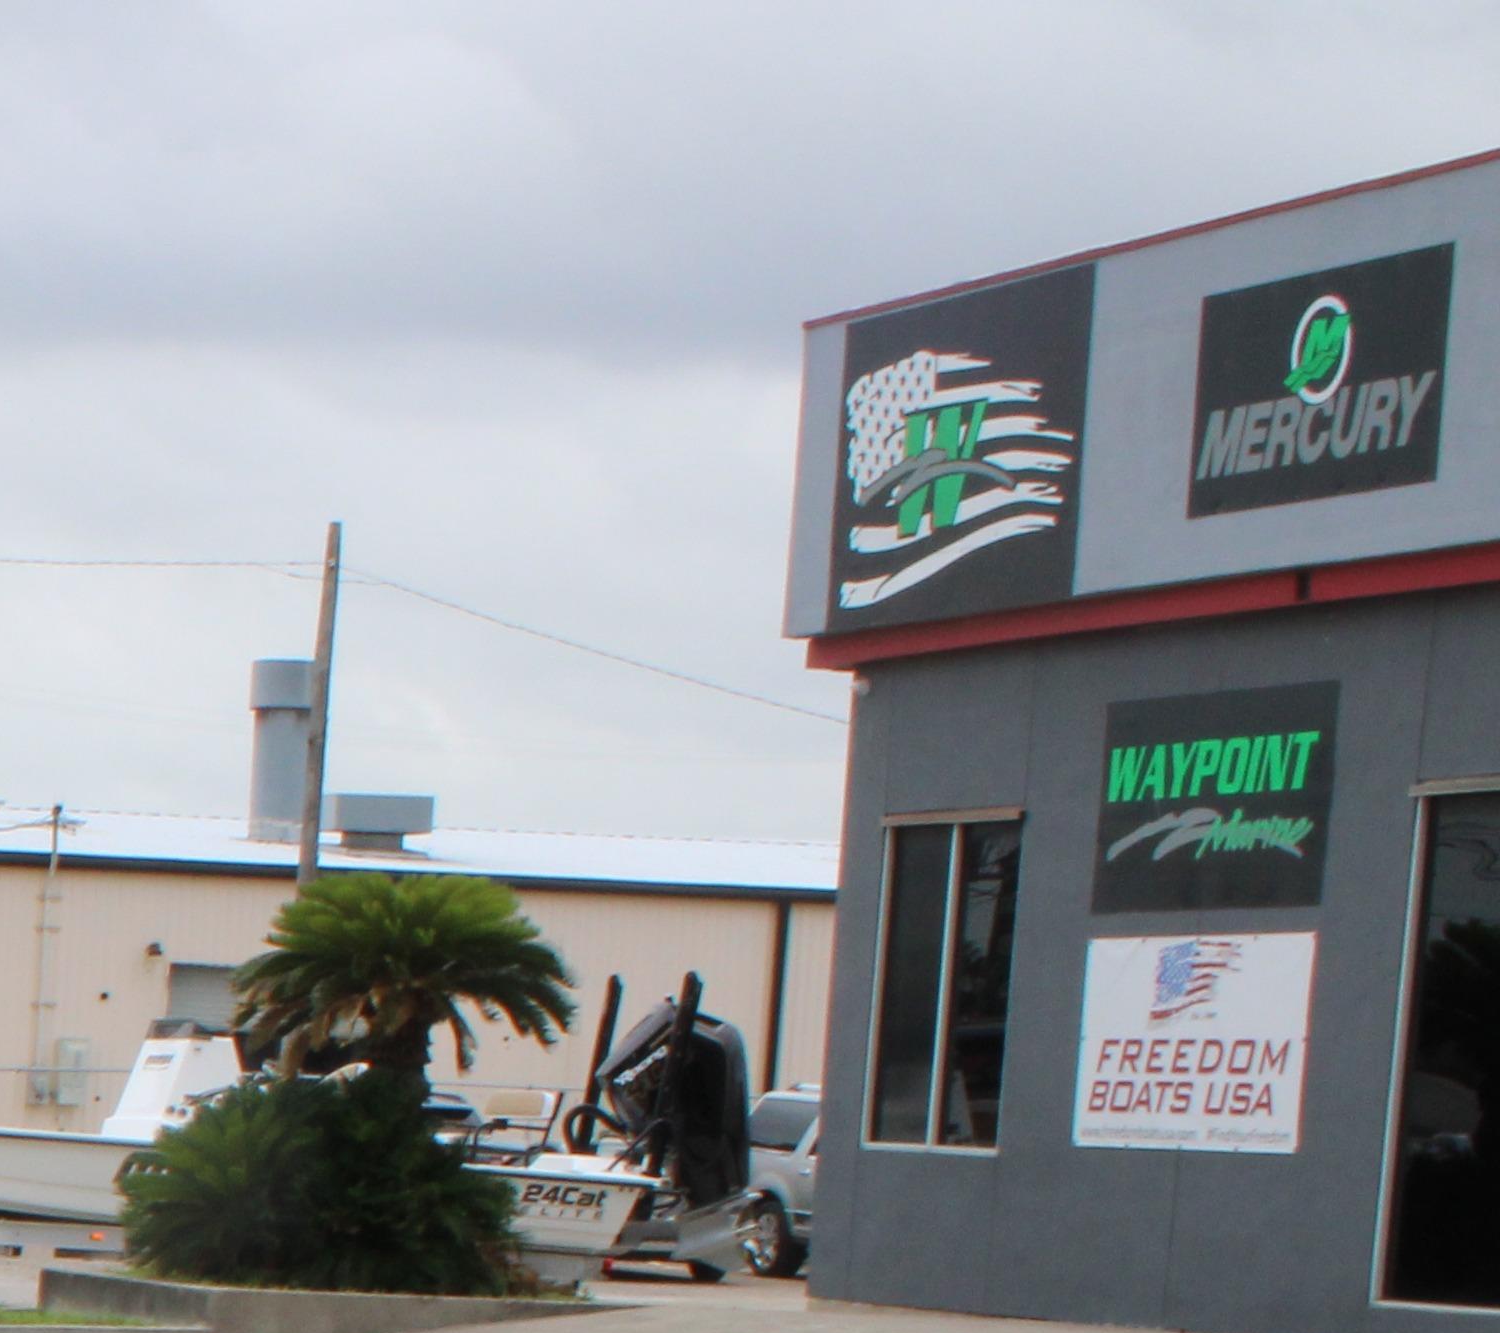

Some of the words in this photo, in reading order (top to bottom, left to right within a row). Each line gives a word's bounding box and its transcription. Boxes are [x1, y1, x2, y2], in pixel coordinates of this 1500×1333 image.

[1196, 370, 1437, 480] MERCURY
[1107, 731, 1320, 802] WAYPOINT
[1095, 1039, 1290, 1074] FREEDOM
[1087, 1080, 1193, 1114] BOATS
[1203, 1082, 1273, 1116] USA
[521, 1184, 608, 1207] 24Cat
